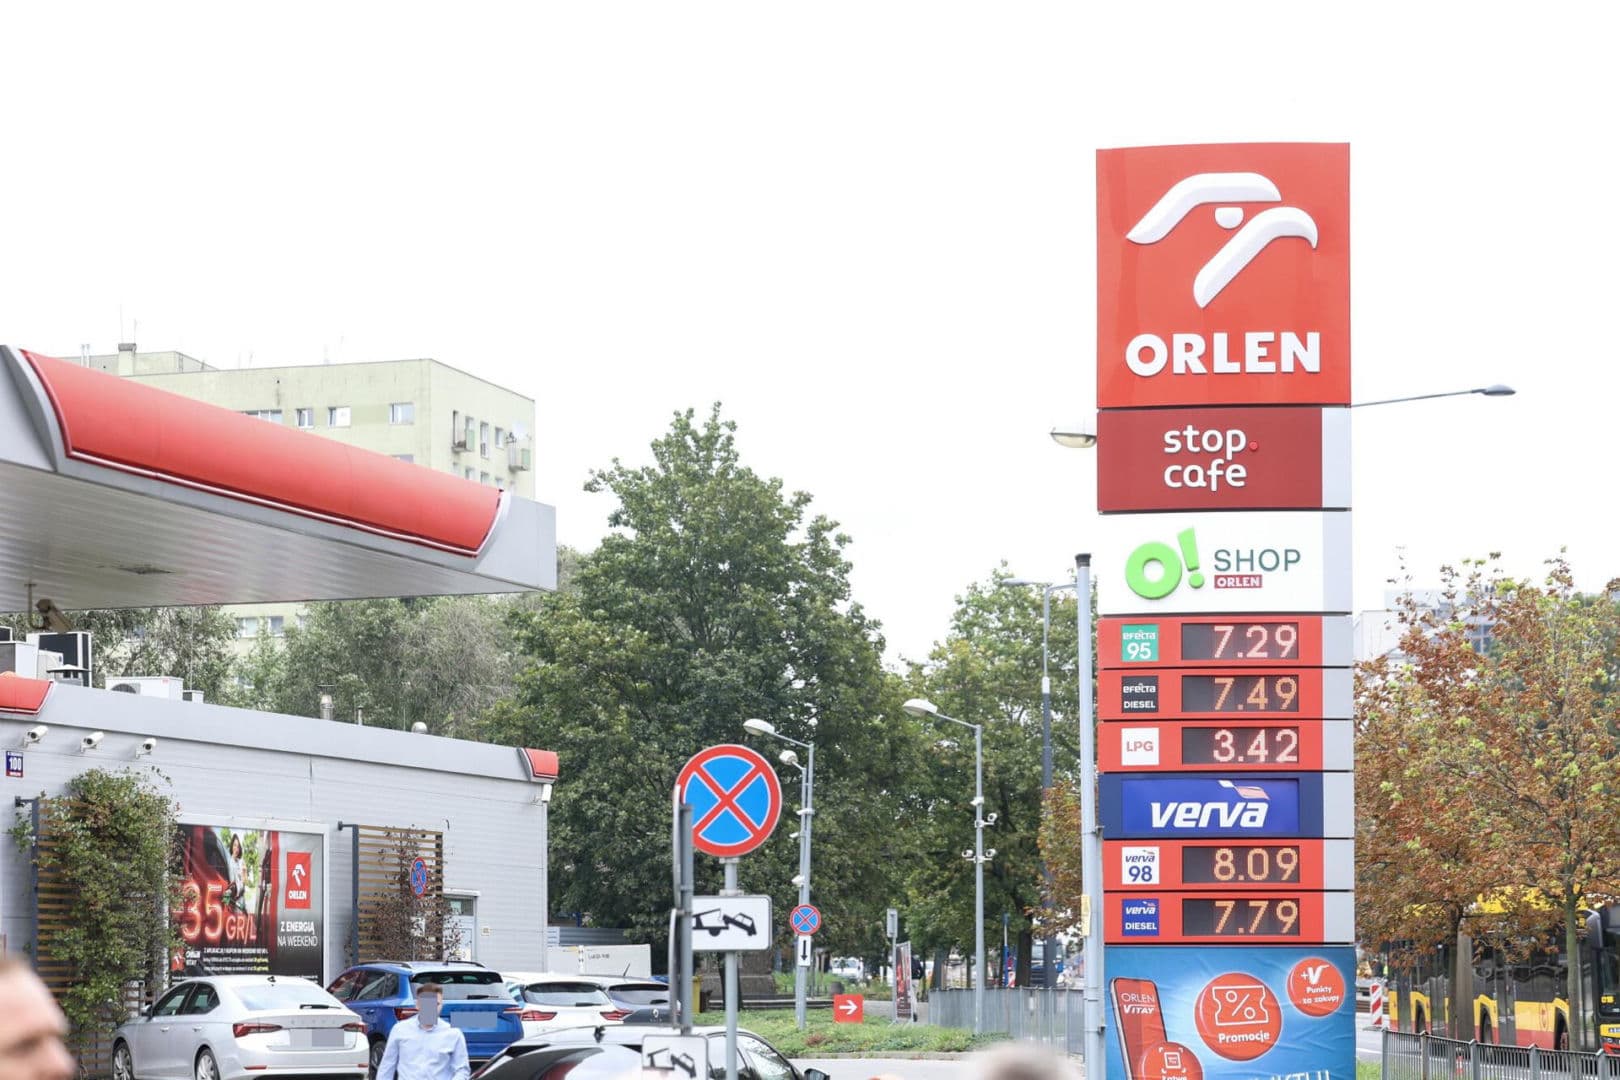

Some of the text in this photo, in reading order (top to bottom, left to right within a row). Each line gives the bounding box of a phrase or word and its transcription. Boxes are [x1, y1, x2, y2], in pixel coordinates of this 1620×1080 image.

[1125, 331, 1321, 377] ORLEN
[1163, 458, 1247, 491] cafe
[1125, 526, 1301, 600] O! SHOP
[1217, 576, 1261, 587] ORLEN
[1213, 624, 1297, 659] 7.29
[1126, 643, 1151, 660] 95
[1213, 677, 1297, 711] 7.49
[1123, 700, 1156, 709] DIESEL
[1126, 729, 1298, 763] LPG 3.42
[1151, 801, 1268, 828] verva
[1125, 848, 1298, 882] verva 8.09
[1128, 866, 1153, 882] 98
[288, 890, 307, 900] ORLEN
[1125, 901, 1298, 935] verva 7.79
[280, 921, 315, 935] Z ENERGIĄ
[1125, 922, 1157, 931] DIESEL
[277, 936, 318, 947] NA WEEKEND
[1121, 993, 1155, 1002] ORLEN
[1306, 986, 1332, 994] Punkty
[1123, 1005, 1155, 1014] VITAY
[1218, 1031, 1270, 1043] Promocje
